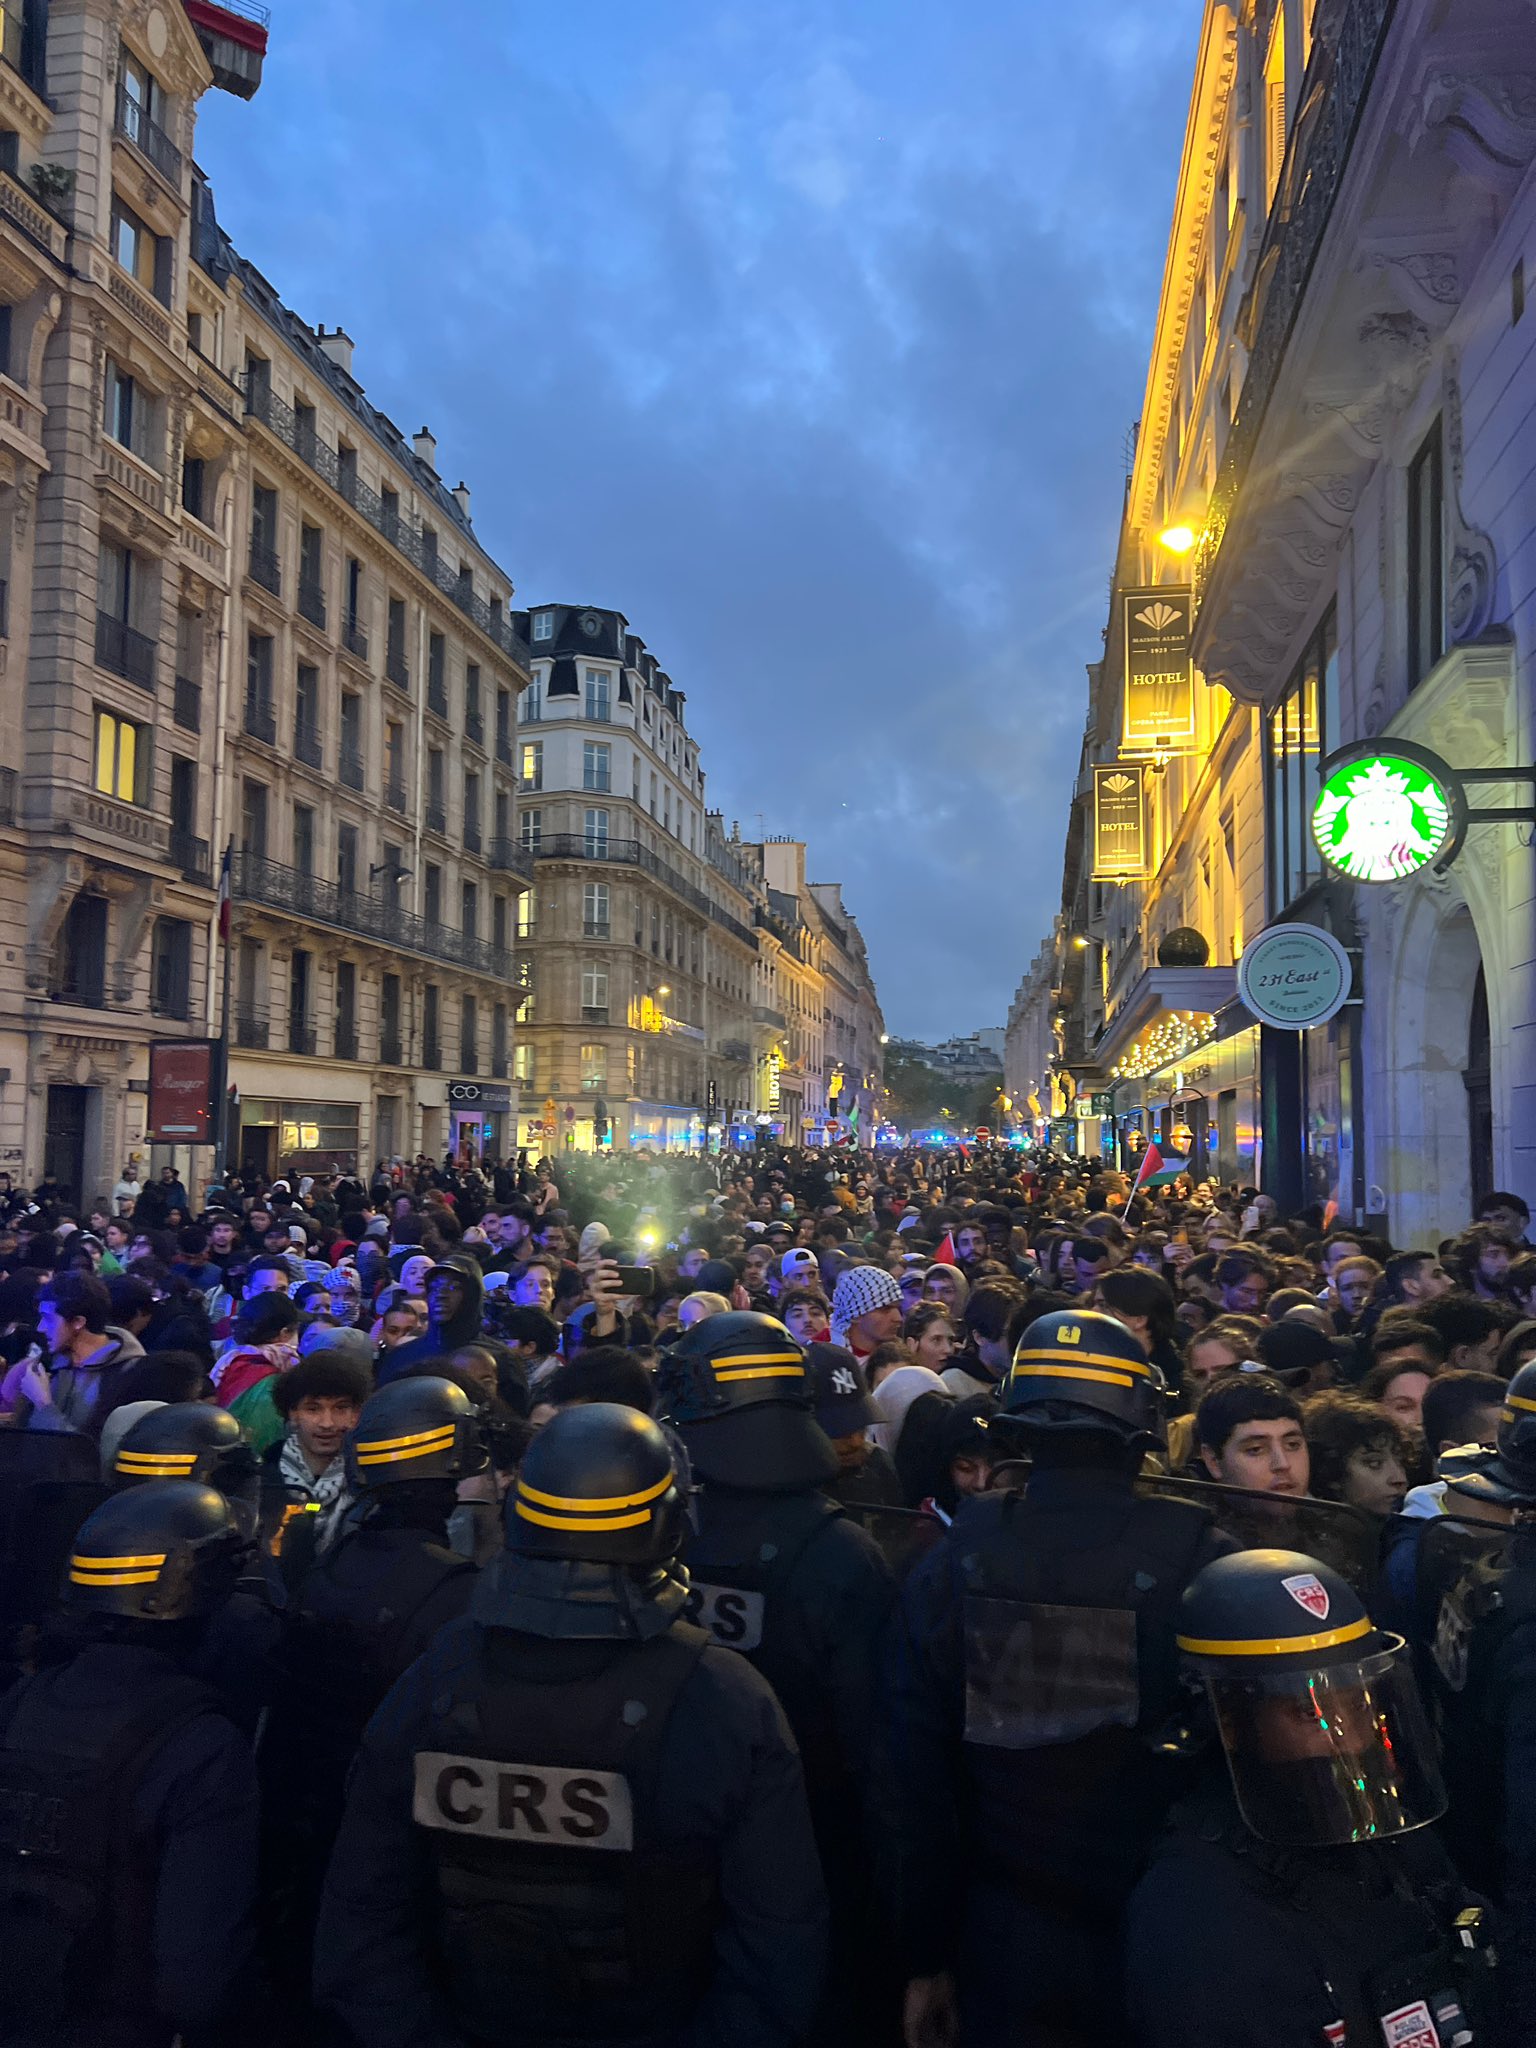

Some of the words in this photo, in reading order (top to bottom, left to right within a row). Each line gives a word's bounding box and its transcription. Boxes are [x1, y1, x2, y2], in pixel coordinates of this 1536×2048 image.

[1132, 672, 1186, 685] HOTEL
[1101, 822, 1138, 831] HOTEL
[1258, 974, 1284, 987] 231
[1285, 969, 1320, 985] East
[1269, 1000, 1298, 1013] SINCE
[769, 1056, 780, 1100] HOTEL
[832, 1367, 857, 1394] NY
[1296, 1586, 1323, 1600] CRS
[435, 1765, 611, 1838] CRS
